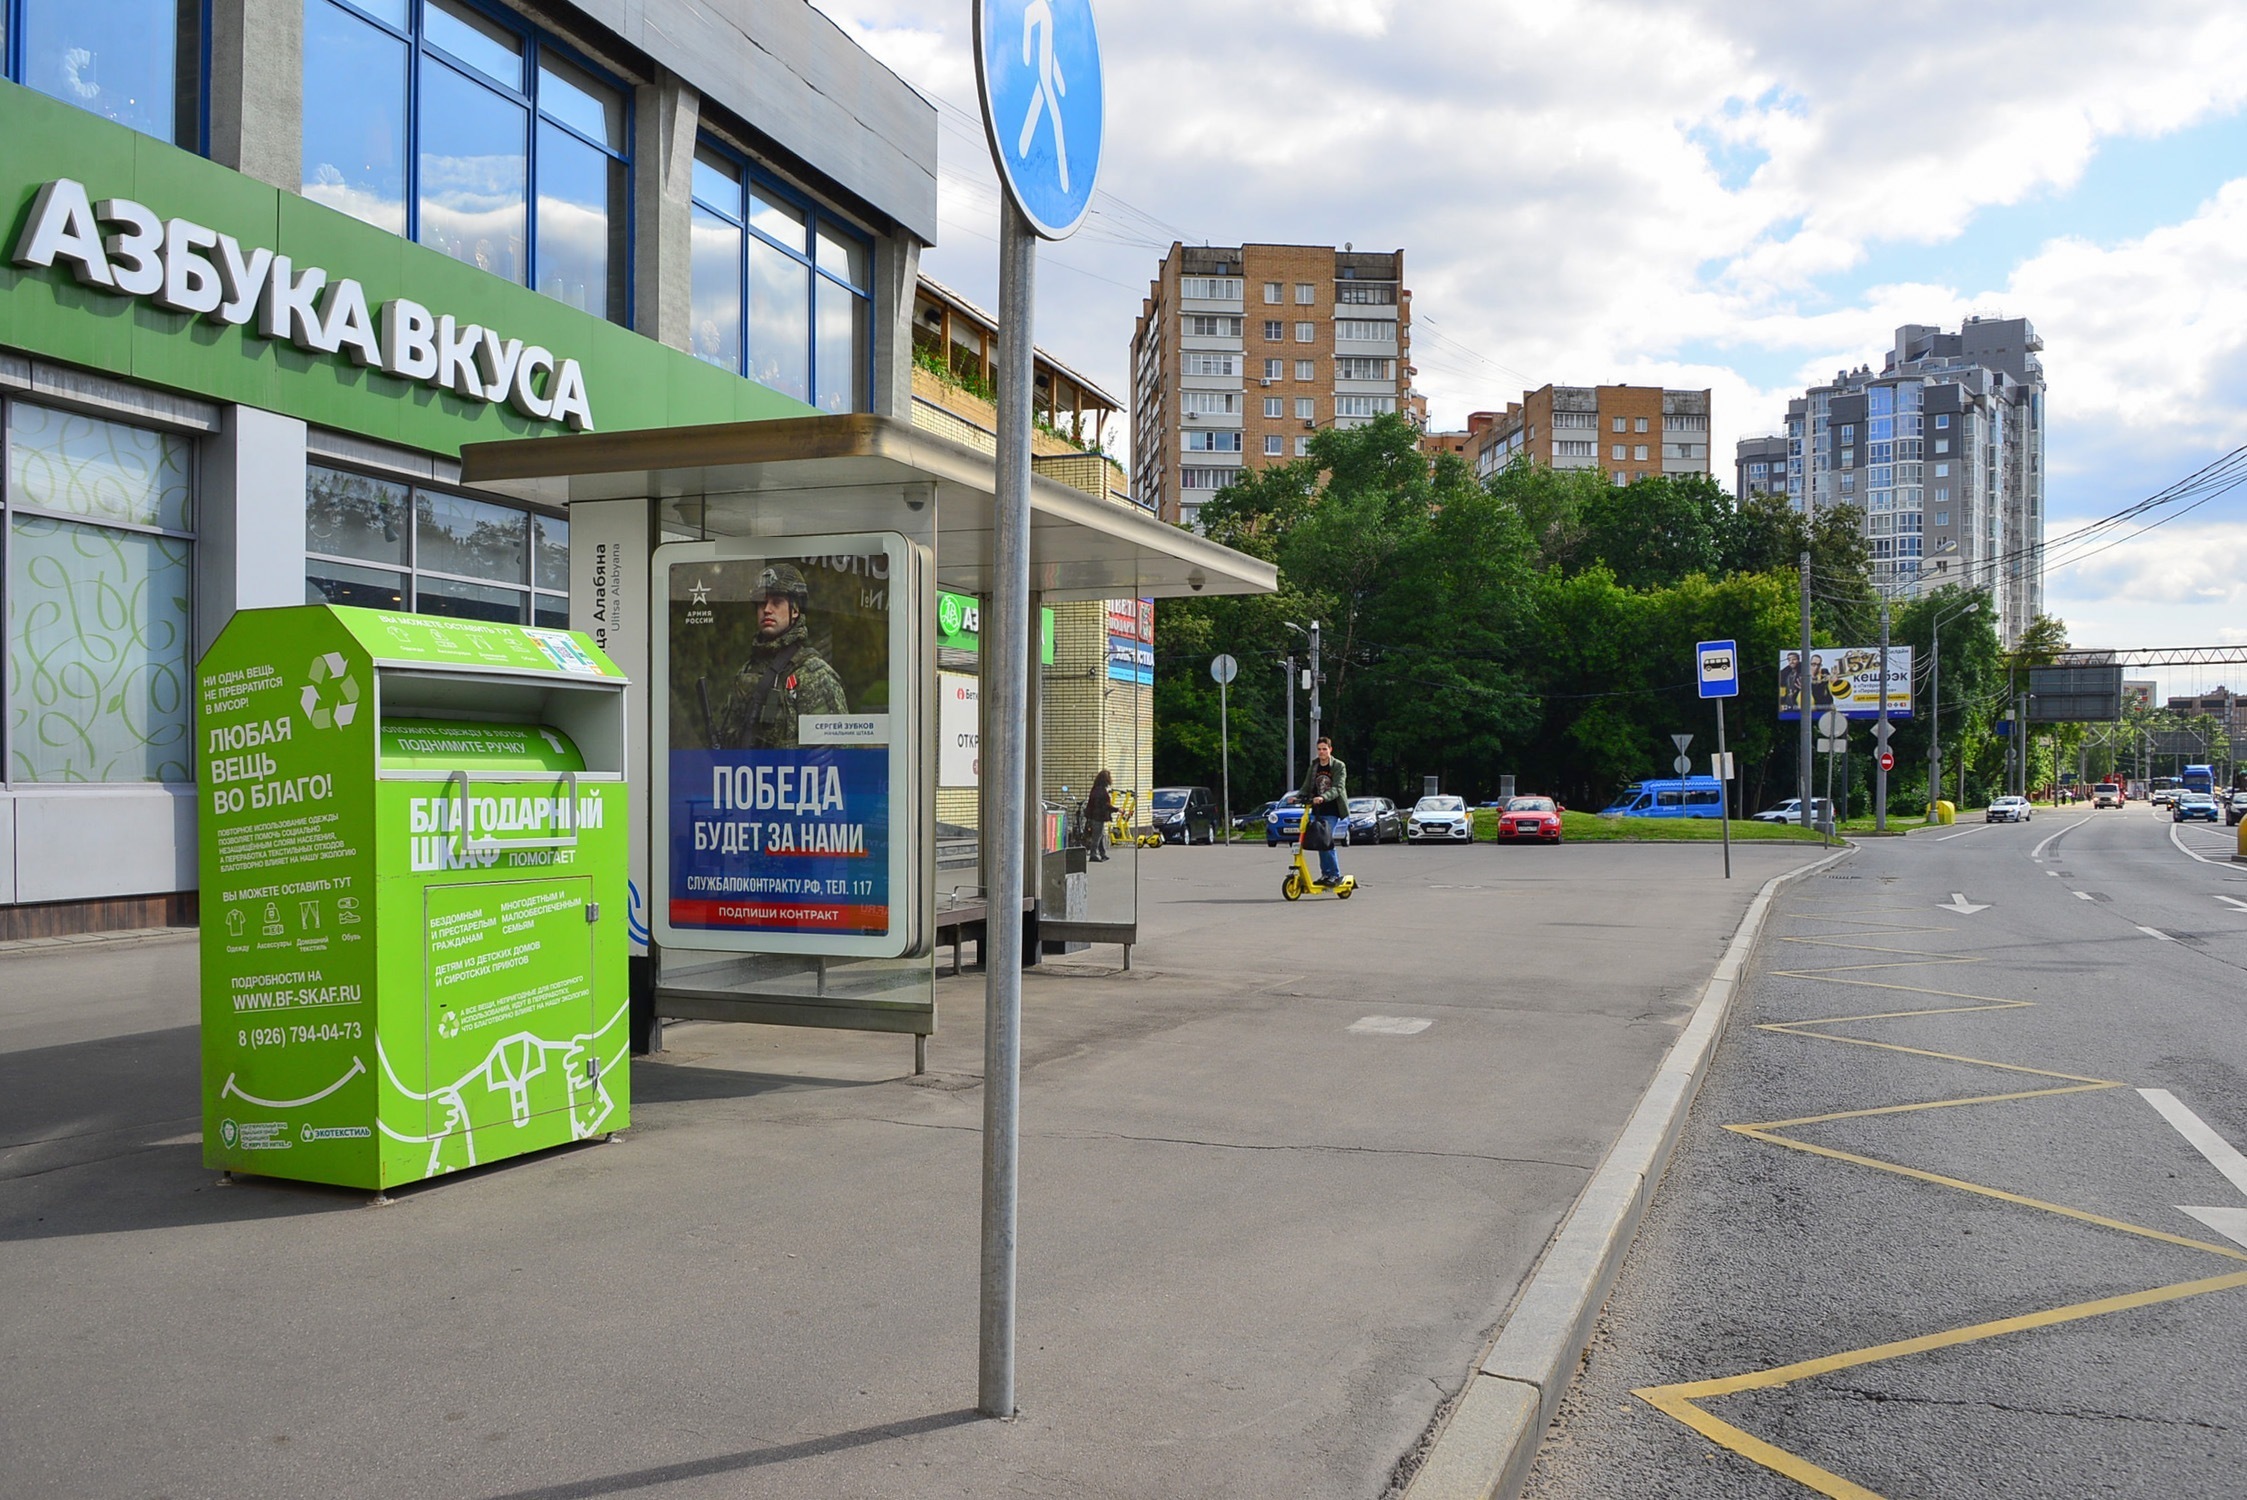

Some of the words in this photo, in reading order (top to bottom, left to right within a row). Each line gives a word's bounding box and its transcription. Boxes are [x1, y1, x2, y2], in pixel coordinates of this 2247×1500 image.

[12, 177, 382, 368] АЗБУКА
[381, 298, 594, 432] ВКУСА
[611, 543, 622, 596] Alabyana
[593, 544, 606, 622] Алабяна
[611, 600, 620, 632] Ulitsa
[687, 610, 712, 618] АРМИЯ
[204, 676, 216, 687] НИ
[218, 670, 244, 686] ОДНА
[247, 664, 274, 680] ВЕЩЬ
[204, 690, 216, 700] НЕ
[218, 676, 283, 698] ПРЕВРАТИТСЯ
[206, 704, 212, 715] В
[214, 698, 249, 713] МУСОР!
[209, 716, 292, 754] ЛЮБАЯ
[440, 728, 482, 738] ОДЕЖДУ
[815, 721, 842, 730] СЕРГЕЙ
[844, 722, 874, 730] ЗУБКОВ
[398, 738, 486, 754] ПОДНИМИТЕ
[486, 742, 526, 754] РУЧКУ
[957, 734, 978, 748] ОТКР
[212, 752, 276, 784] ВЕЩЬ
[214, 788, 244, 814] ВО
[251, 774, 332, 808] БЛАГО!
[713, 766, 844, 816] ПОБЕДА
[218, 825, 253, 836] ПОВТОРНОЕ
[254, 818, 306, 832] ИСПОЛЬЗОВАНИЕ
[308, 813, 338, 824] ОДЕЖДЫ
[254, 831, 280, 841] ПОМОЧЬ
[282, 825, 320, 837] СОЦИАЛЬНО
[268, 845, 313, 858] ТЕКСТИЛЬНЫХ
[314, 840, 345, 851] ОТХОДОВ
[694, 822, 762, 854] БУДЕТ
[768, 823, 795, 852] ЗА
[800, 824, 864, 854] НАМИ
[220, 860, 264, 872] БЛАГОТВОРНО
[290, 856, 299, 864] НА
[410, 834, 500, 872] ШКАФ
[509, 850, 576, 867] ПОМОГАЕТ
[223, 890, 238, 902] ВЫ
[240, 886, 280, 900] МОЖЕТЕ
[282, 880, 332, 895] ОСТАВИТЬ
[332, 876, 352, 889] ТУТ
[687, 876, 824, 896] СЛУЖБАПОКОНТРАКТУ.РФ,
[826, 880, 848, 895] ТЕЛ.
[853, 881, 872, 896] 117
[501, 892, 558, 912] МНОГОДЕТНЫМ
[559, 890, 564, 899] И
[502, 898, 582, 922] МАЛООБЕСПЕЧЕННЫМ
[430, 908, 482, 928] БЕЗДОМНЫМ
[718, 906, 778, 919] ПОДПИШИ
[780, 909, 839, 921] КОНТРАКТ
[432, 931, 438, 940] И
[439, 918, 497, 938] ПРЕСТАРЕЛЫМ
[502, 920, 534, 935] СЕМЬЯМ
[432, 932, 484, 952] ГРАЖДАНАМ
[435, 962, 463, 977] ДЕТЯМ
[464, 959, 475, 967] ИЗ
[477, 948, 512, 966] ДЕТСКИХ
[514, 941, 541, 956] ДОМОВ
[232, 972, 306, 990] ПОДРОБНОСТИ
[308, 970, 322, 982] НА
[436, 979, 442, 987] И
[444, 968, 492, 985] СИРОТСКИХ
[492, 955, 529, 971] ПРИЮТОВ
[233, 984, 361, 1010] WWW.BF-SKAF.RU
[238, 1030, 248, 1046] 8
[251, 1027, 286, 1050] (926)
[290, 1022, 362, 1043] 794-04-73
[315, 1128, 370, 1138] ЭКОТЕКСТИЛЬ
